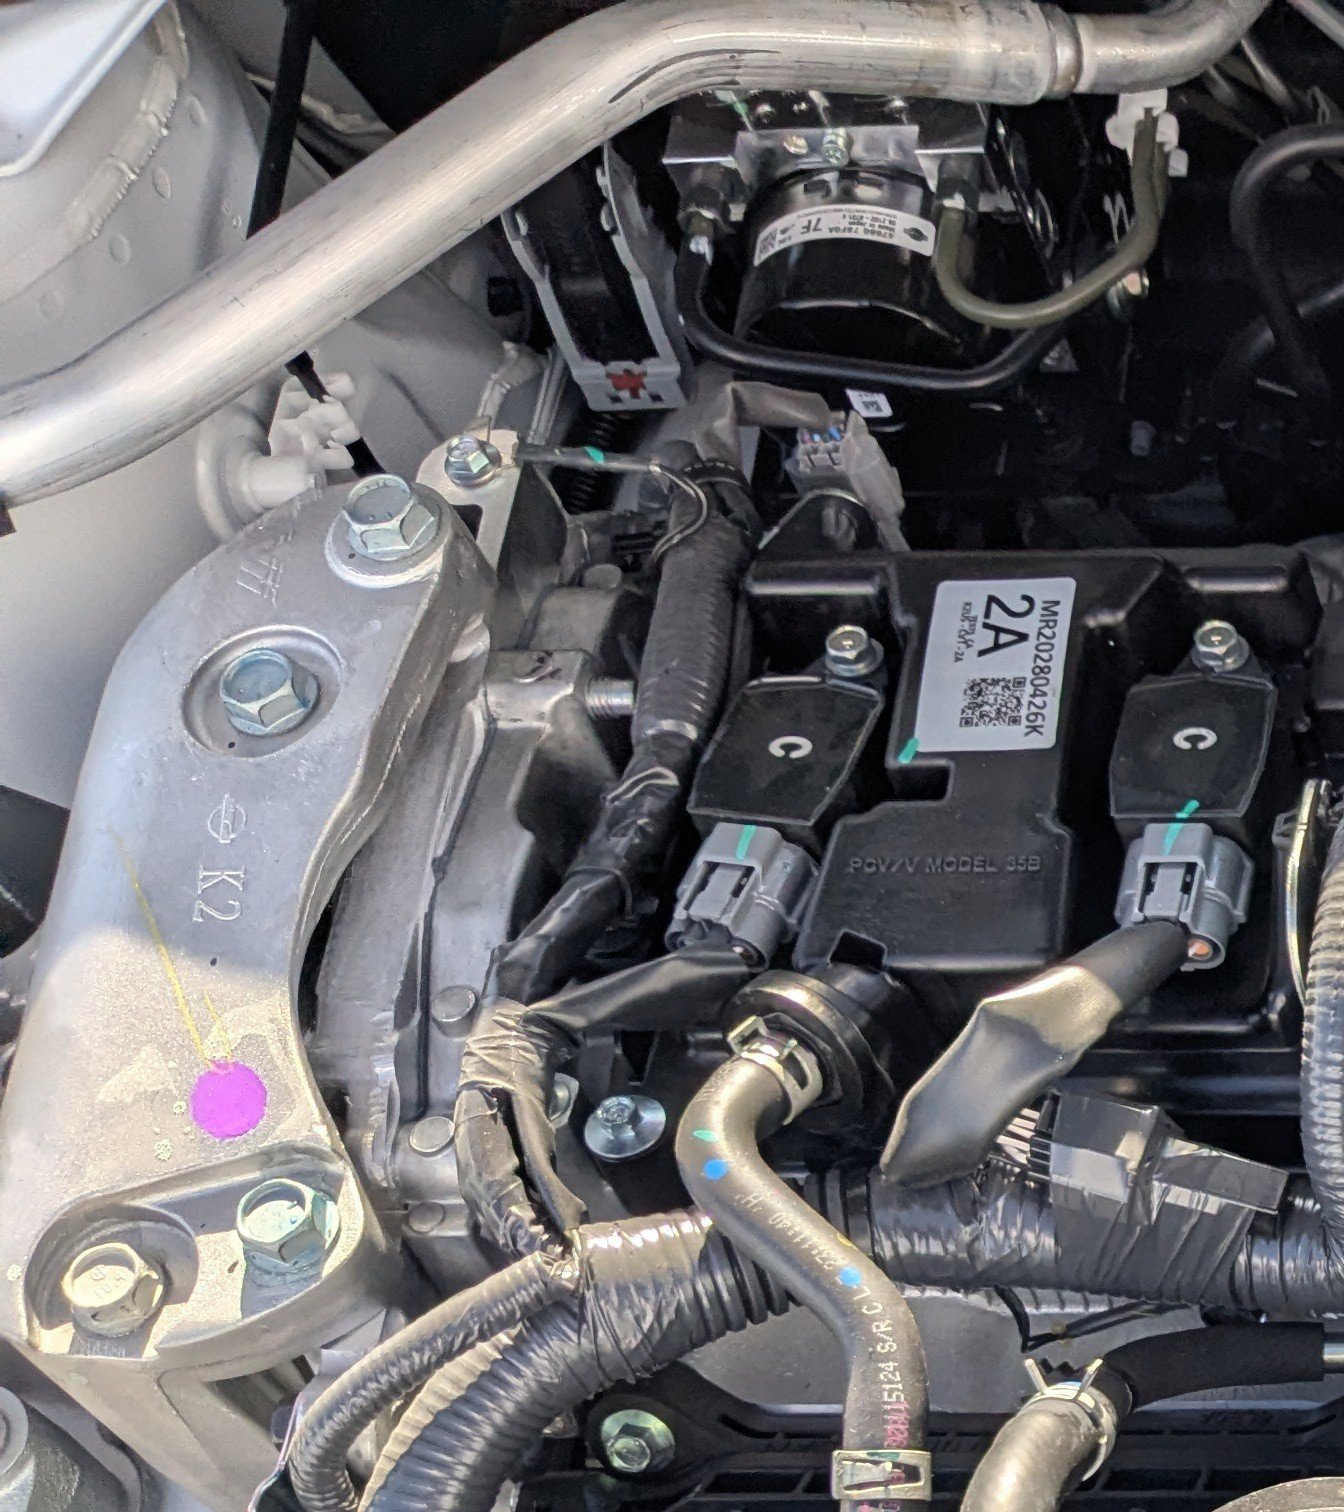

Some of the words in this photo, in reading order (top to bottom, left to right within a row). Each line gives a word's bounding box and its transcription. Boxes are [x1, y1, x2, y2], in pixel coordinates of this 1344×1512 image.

[801, 217, 822, 235] 7F
[977, 593, 1036, 658] 2A
[1023, 599, 1061, 737] MR20280426K
[768, 735, 813, 758] C
[1172, 726, 1218, 751] C
[925, 855, 999, 873] MODEL
[192, 865, 246, 922] K2
[871, 1319, 898, 1353] S/R
